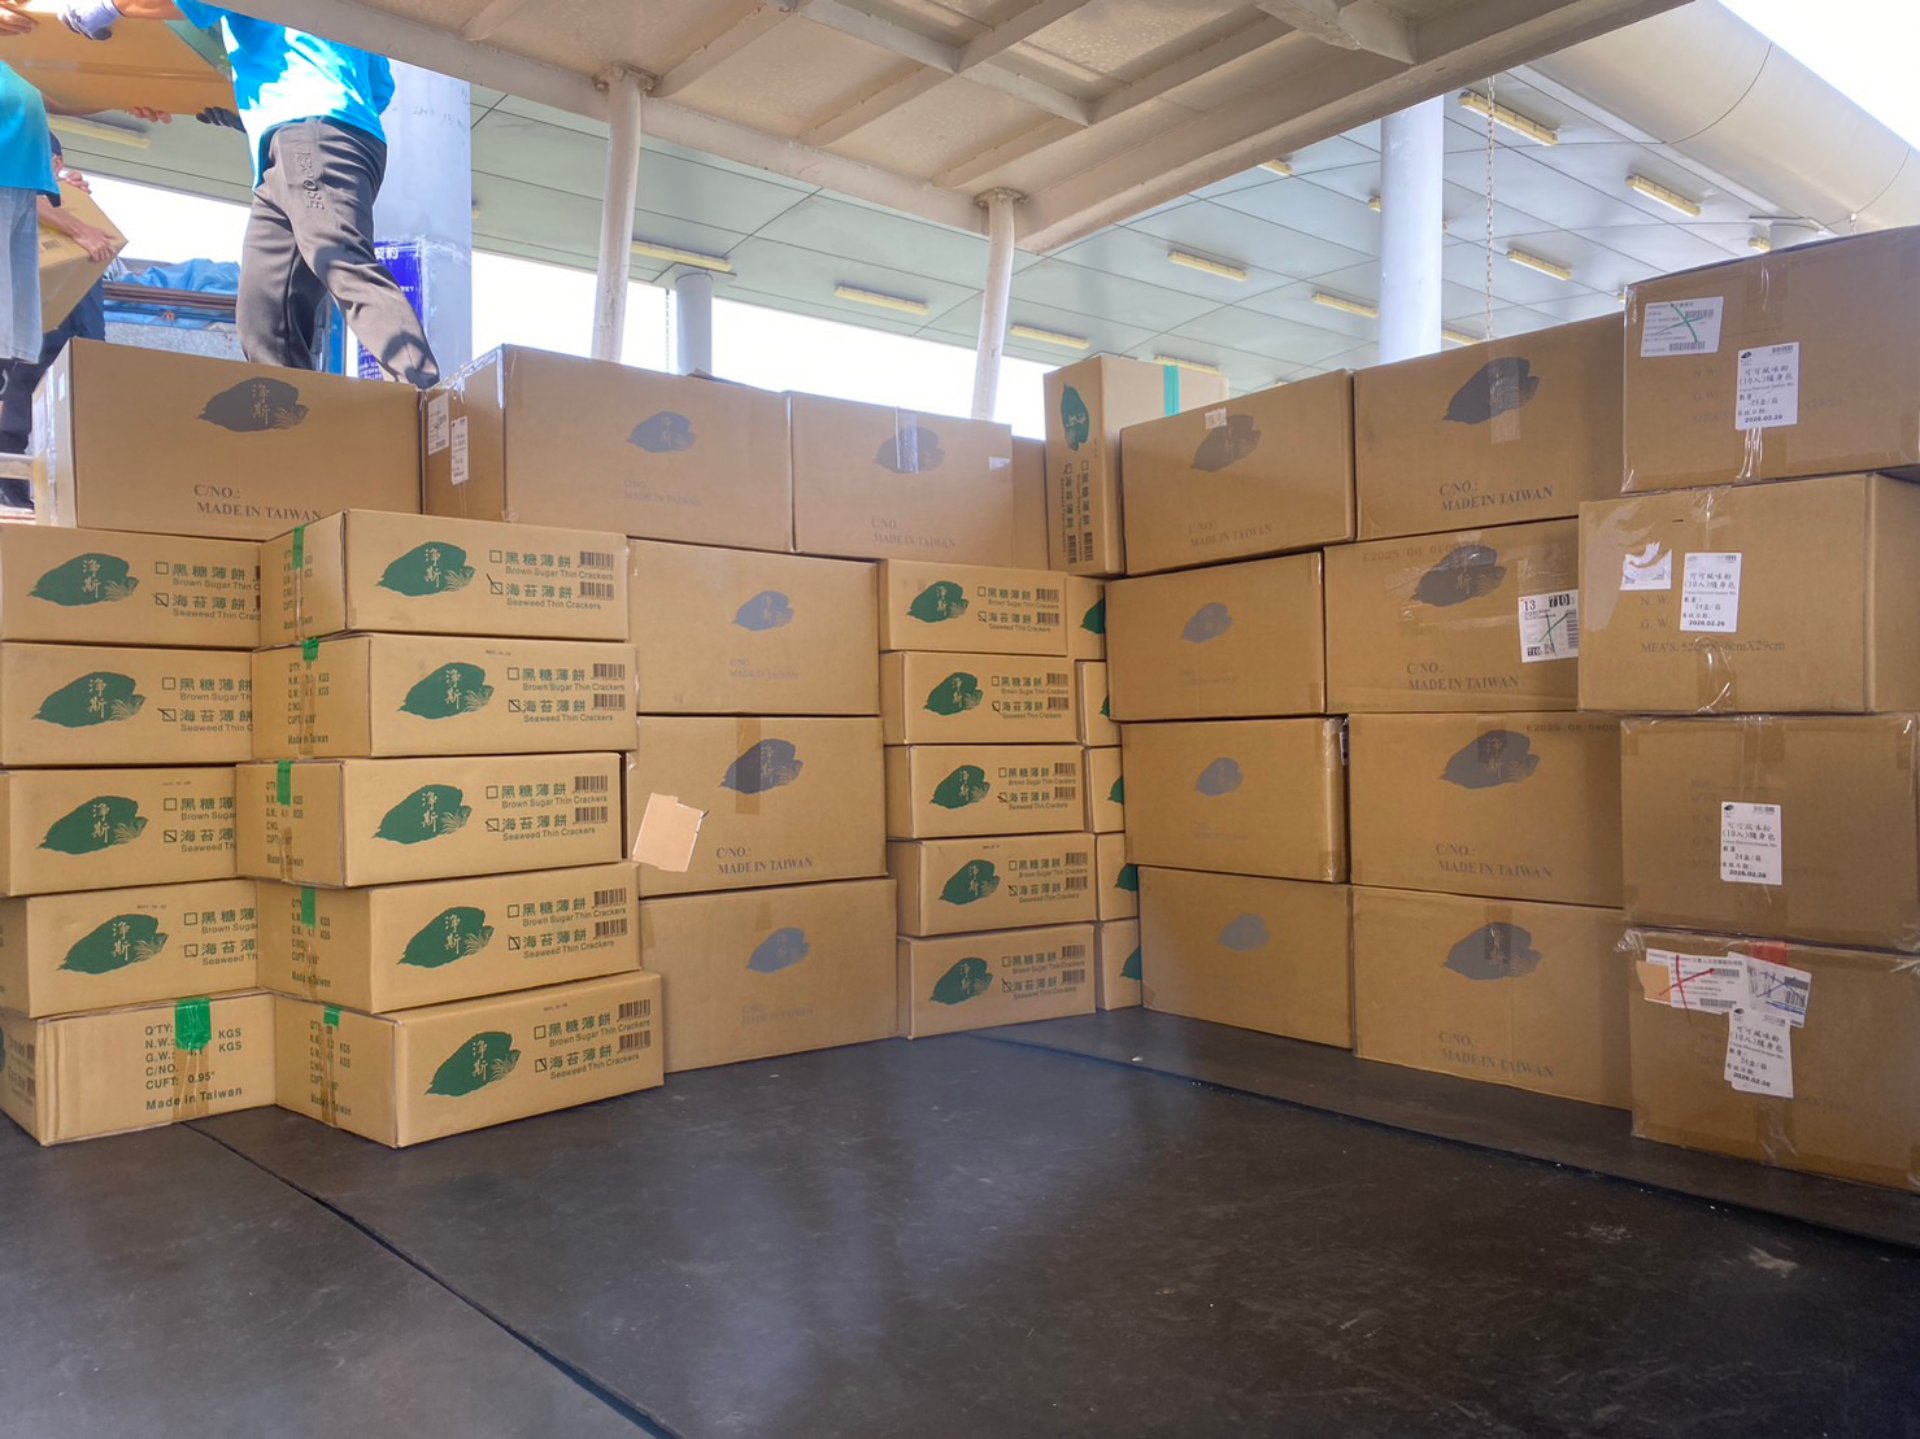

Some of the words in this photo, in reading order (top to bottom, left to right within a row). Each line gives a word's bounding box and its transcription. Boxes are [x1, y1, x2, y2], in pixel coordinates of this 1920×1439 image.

[1442, 495, 1480, 511] MADE
[1482, 493, 1496, 506] IN
[1499, 486, 1553, 504] TAIWAN
[197, 502, 244, 516] MADE
[246, 505, 260, 517] IN
[266, 505, 322, 522] TAIWAN
[505, 551, 572, 568] 黑糖薄餅
[173, 563, 247, 581] 黑糖薄餅
[425, 548, 440, 588] 淨斯
[505, 566, 533, 576] Brown
[534, 568, 558, 579] Sugar
[559, 569, 577, 578] Thin
[579, 570, 613, 580] Crackers
[82, 558, 101, 598] 淨斯
[173, 578, 203, 589] Brown
[205, 579, 231, 591] Sugar
[233, 579, 253, 591] Thin
[506, 584, 573, 599] 海苔薄餅
[173, 594, 246, 611] 海苔薄餅
[507, 598, 546, 608] Seaweed
[547, 600, 565, 608] Thin
[566, 600, 601, 611] Crackers
[173, 608, 216, 619] Seaweed
[217, 610, 237, 620] Thin
[523, 668, 585, 682] 黑糖薄餅
[1409, 678, 1447, 690] MADE
[1449, 677, 1463, 689] IN
[1466, 675, 1519, 689] TAIWAN
[180, 678, 253, 692] 黑糖薄餅
[446, 669, 461, 709] 淨斯
[523, 683, 548, 691] Brown
[550, 683, 573, 692] Sugar
[574, 683, 591, 691] Thin
[592, 683, 625, 691] Crackers
[88, 678, 107, 718] 淨斯
[180, 692, 210, 702] Brown
[212, 692, 239, 703] Sugar
[524, 699, 586, 713] 海苔薄餅
[180, 709, 253, 723] 海苔薄餅
[562, 714, 579, 722] Thin
[580, 714, 613, 722] Crackers
[180, 723, 223, 733] Seaweed
[225, 723, 245, 732] Thin
[502, 783, 566, 799] 黑糖薄餅
[181, 797, 234, 811] 黑糖薄
[502, 800, 528, 809] Brown
[530, 799, 553, 809] Sugar
[556, 796, 573, 805] Thin
[573, 795, 607, 804] Crackers
[181, 811, 210, 821] Brown
[421, 791, 438, 832] 淨斯
[93, 803, 110, 843] 淨斯
[502, 815, 567, 831] 海苔薄餅
[180, 829, 234, 843] 海苔薄
[503, 832, 541, 841] Seaweed
[543, 829, 559, 837] Thin
[561, 827, 596, 836] Crackers
[181, 843, 223, 853] Seaweed
[719, 861, 752, 875] MADE
[754, 861, 765, 872] IN
[771, 857, 813, 871] TAIWAN
[1438, 861, 1478, 873] MADE
[1479, 863, 1493, 874] IN
[1499, 864, 1552, 879] TAIWAN
[523, 898, 586, 917] 黑糖薄餅
[201, 907, 256, 925] 黑糖薄
[523, 917, 548, 927] Brown
[550, 914, 575, 924] Sugar
[575, 912, 592, 921] Thin
[593, 907, 626, 918] Crackers
[201, 923, 230, 935] Brown
[445, 914, 461, 955] 淨斯
[113, 921, 130, 961] 淨斯
[523, 929, 586, 949] 海苔薄餅
[201, 939, 256, 957] 海苔薄
[524, 949, 561, 960] Seaweed
[563, 945, 579, 954] Thin
[580, 940, 614, 951] Crackers
[202, 955, 243, 966] Seaweed
[145, 1023, 173, 1036] Q'TY:
[549, 1012, 611, 1037] 黑糖薄餅
[218, 1028, 241, 1039] KGS
[550, 1037, 575, 1048] Brown
[576, 1032, 600, 1044] Sugar
[600, 1027, 617, 1037] Thin
[618, 1019, 650, 1033] Crackers
[218, 1041, 242, 1053] KGS
[472, 1040, 488, 1080] 淨斯
[550, 1044, 612, 1069] 海苔薄餅
[1442, 1049, 1480, 1064] MADE
[1481, 1053, 1496, 1067] IN
[1500, 1057, 1553, 1078] TAIWAN
[550, 1068, 587, 1080] Seaweed
[589, 1063, 605, 1073] Thin
[606, 1053, 640, 1067] Crackers
[145, 1077, 179, 1090] CUFT:
[146, 1096, 180, 1111] Made
[182, 1094, 195, 1104] in
[199, 1086, 243, 1101] Taiwan
